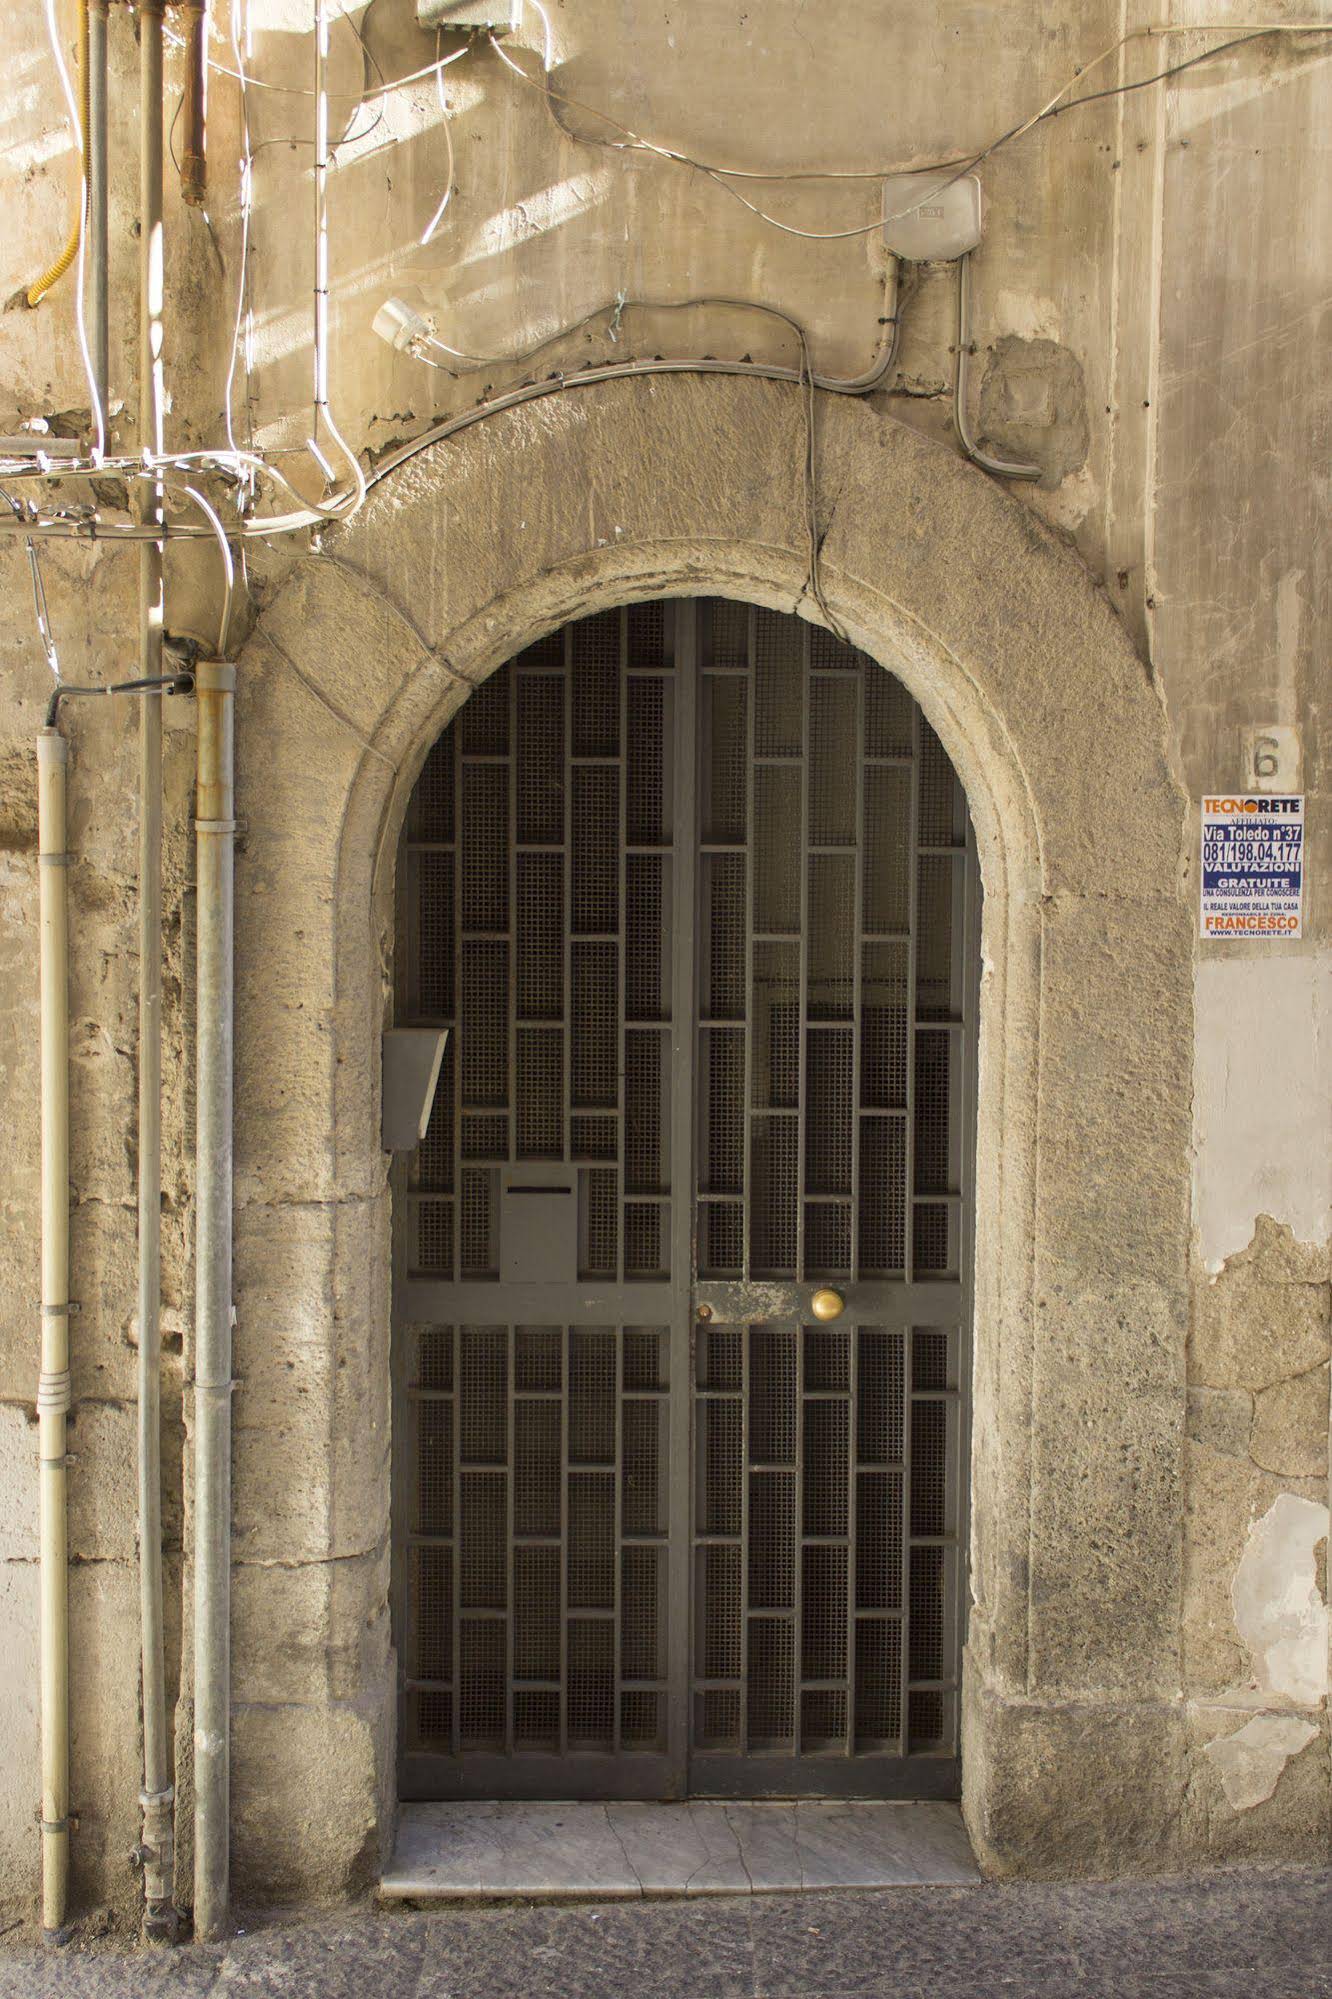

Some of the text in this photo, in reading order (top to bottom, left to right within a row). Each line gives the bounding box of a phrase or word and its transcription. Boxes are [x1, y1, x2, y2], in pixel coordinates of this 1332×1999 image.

[1254, 737, 1279, 777] 6
[1204, 826, 1301, 841] Via Toledo n°37
[1203, 843, 1301, 861] 081/198.04.177
[1204, 863, 1300, 872] VALUTAZIONI
[1217, 879, 1290, 888] GRATUITE
[1203, 888, 1300, 897] UNA CONSULENZA PER CONOSCERE
[1203, 903, 1299, 911] IL REALE VALORE DELLA TUA CASA
[1205, 917, 1299, 929] FRANCESCO
